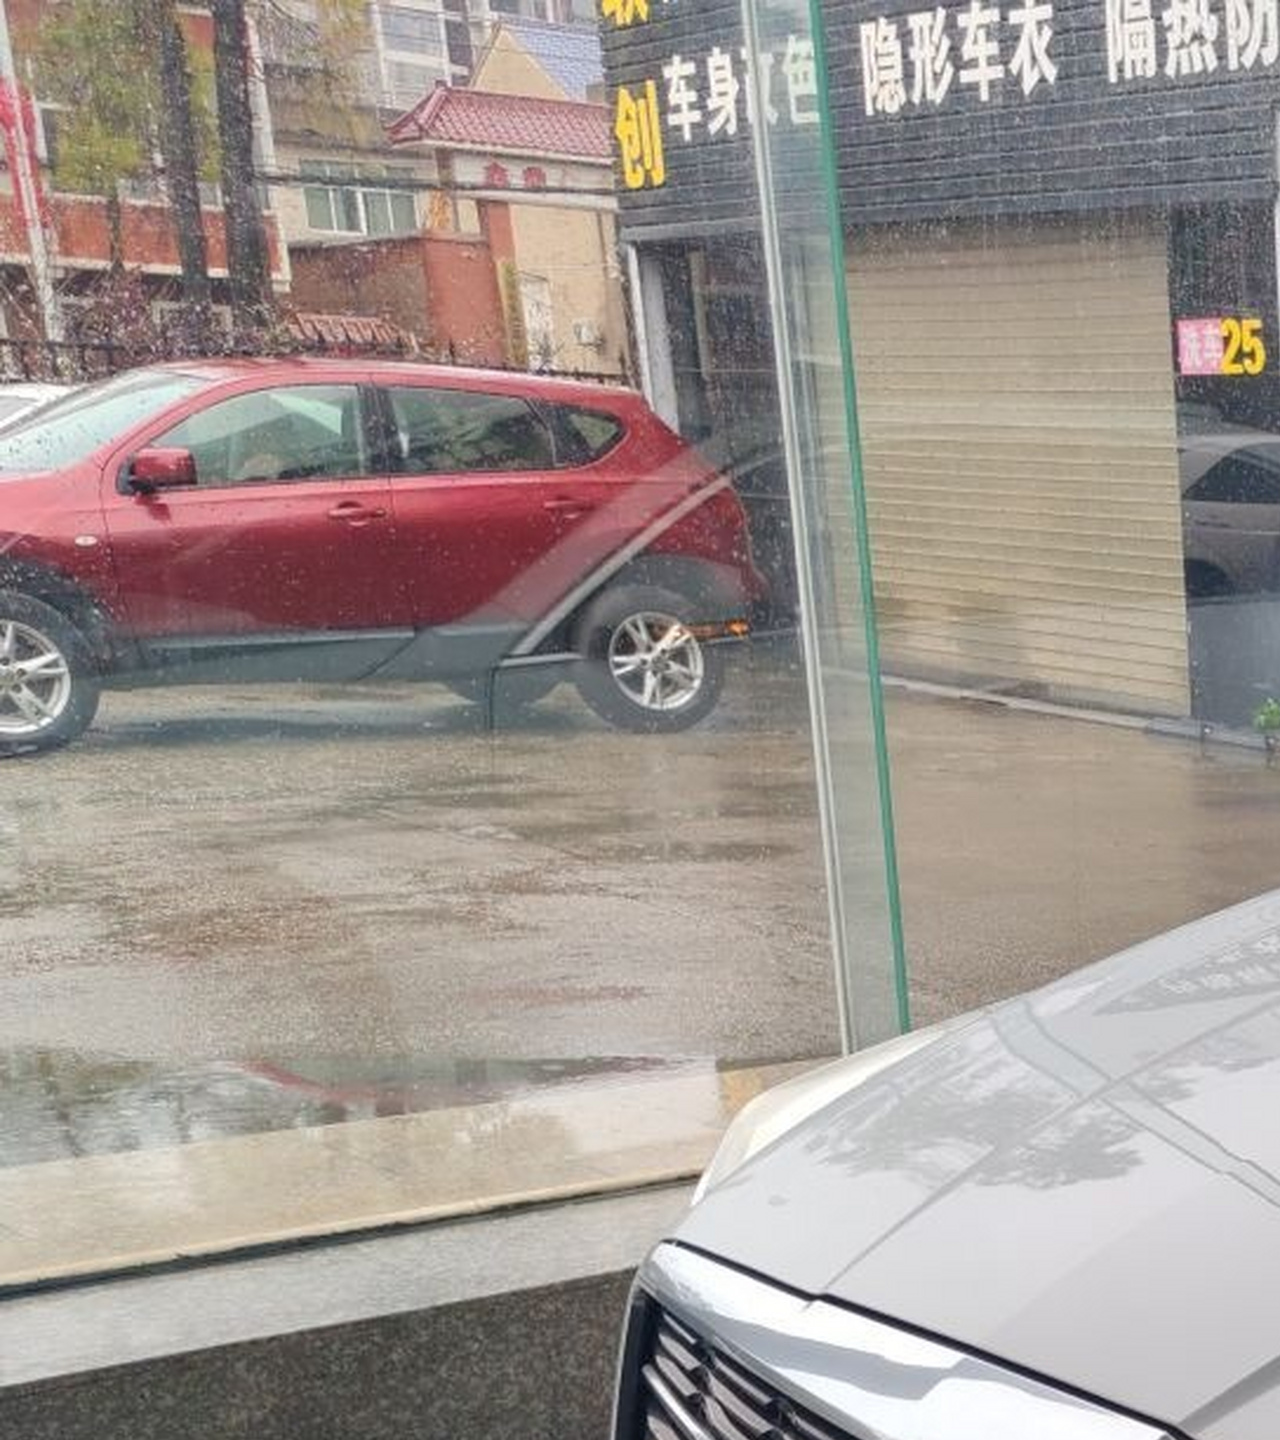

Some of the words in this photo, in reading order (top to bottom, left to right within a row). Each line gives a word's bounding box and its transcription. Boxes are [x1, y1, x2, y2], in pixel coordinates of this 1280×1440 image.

[859, 0, 1059, 116] 隐形车衣
[1221, 317, 1267, 376] 25
